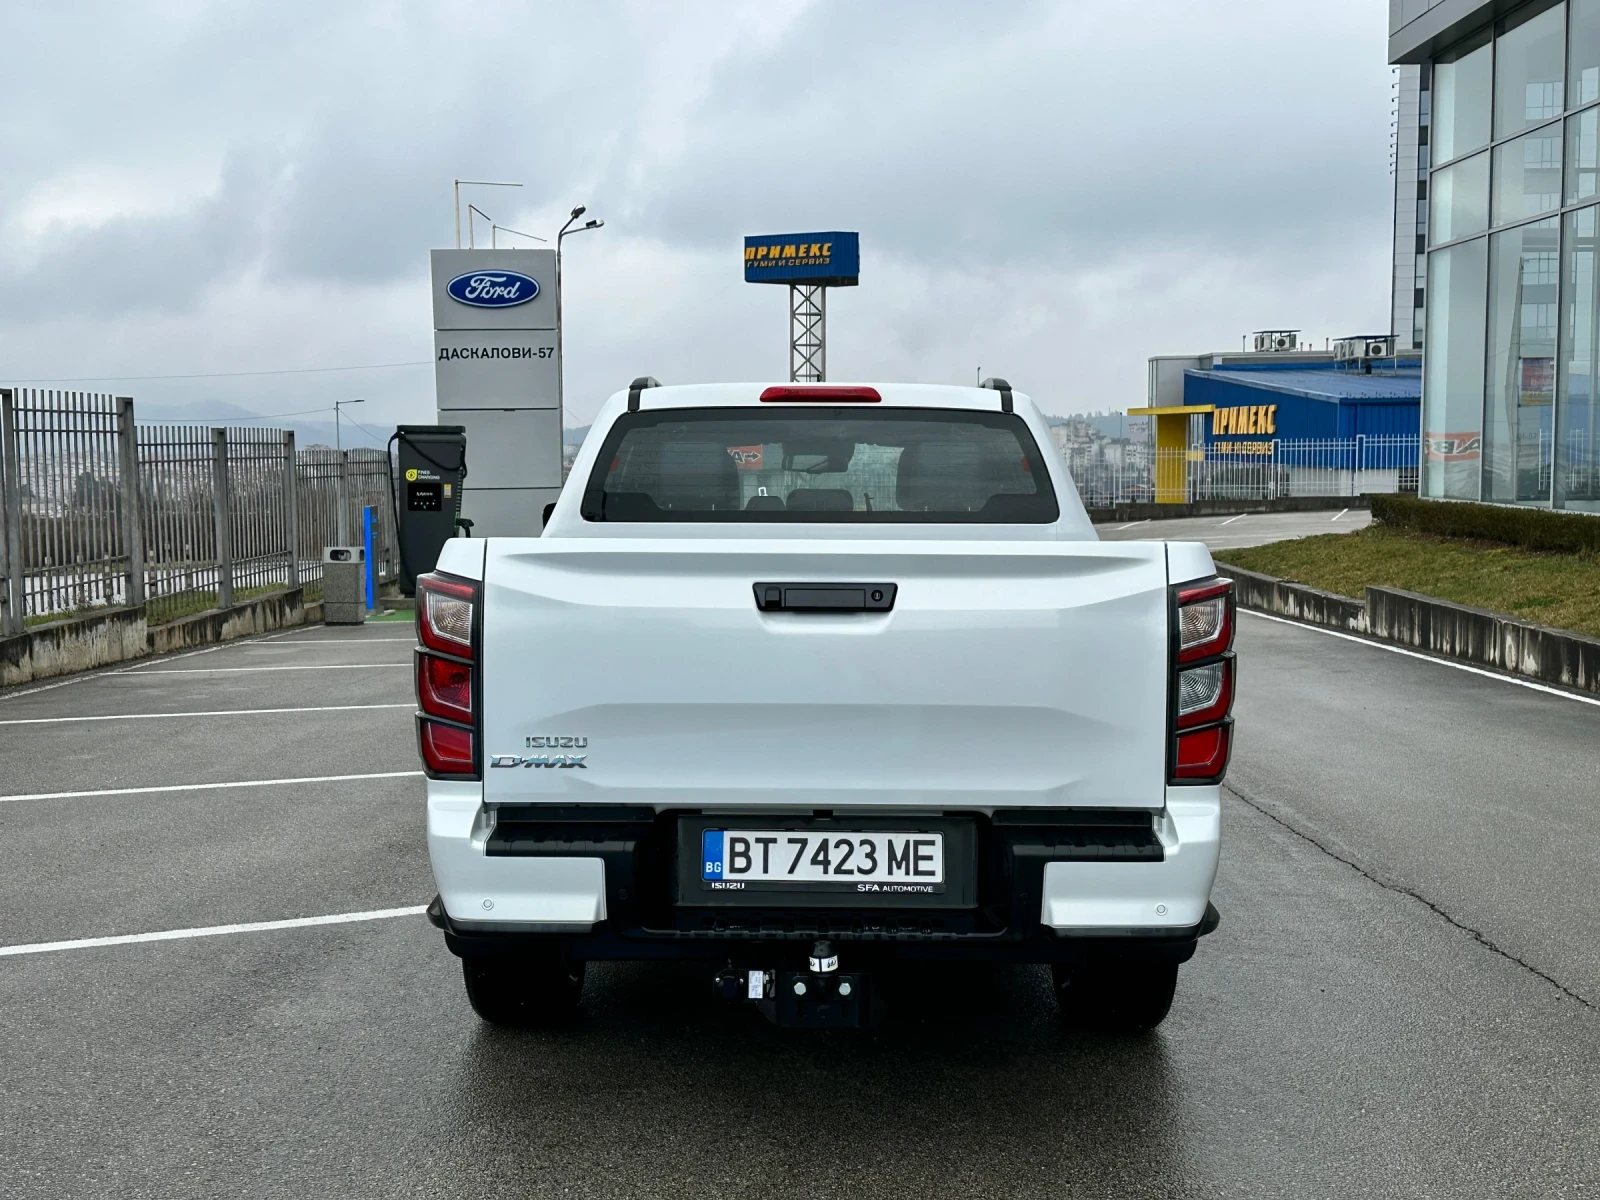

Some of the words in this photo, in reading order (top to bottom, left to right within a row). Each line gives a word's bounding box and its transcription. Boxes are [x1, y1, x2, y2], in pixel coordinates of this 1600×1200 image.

[745, 243, 832, 259] ПРИМЕКС
[747, 260, 775, 268] ГУМИ
[779, 259, 785, 267] И
[788, 258, 830, 266] СЕРВИЗ
[465, 275, 521, 299] Ford
[438, 347, 554, 361] ДАСКАЛОВИ-57
[1212, 404, 1277, 435] ПРИМЕКС
[525, 736, 588, 748] ISUZU
[490, 754, 588, 768] D-MAX
[728, 837, 778, 875] BT
[787, 837, 878, 876] 7423
[887, 839, 936, 877] ME
[705, 862, 722, 873] BG
[711, 882, 745, 890] ISUZU
[857, 884, 880, 892] SFA
